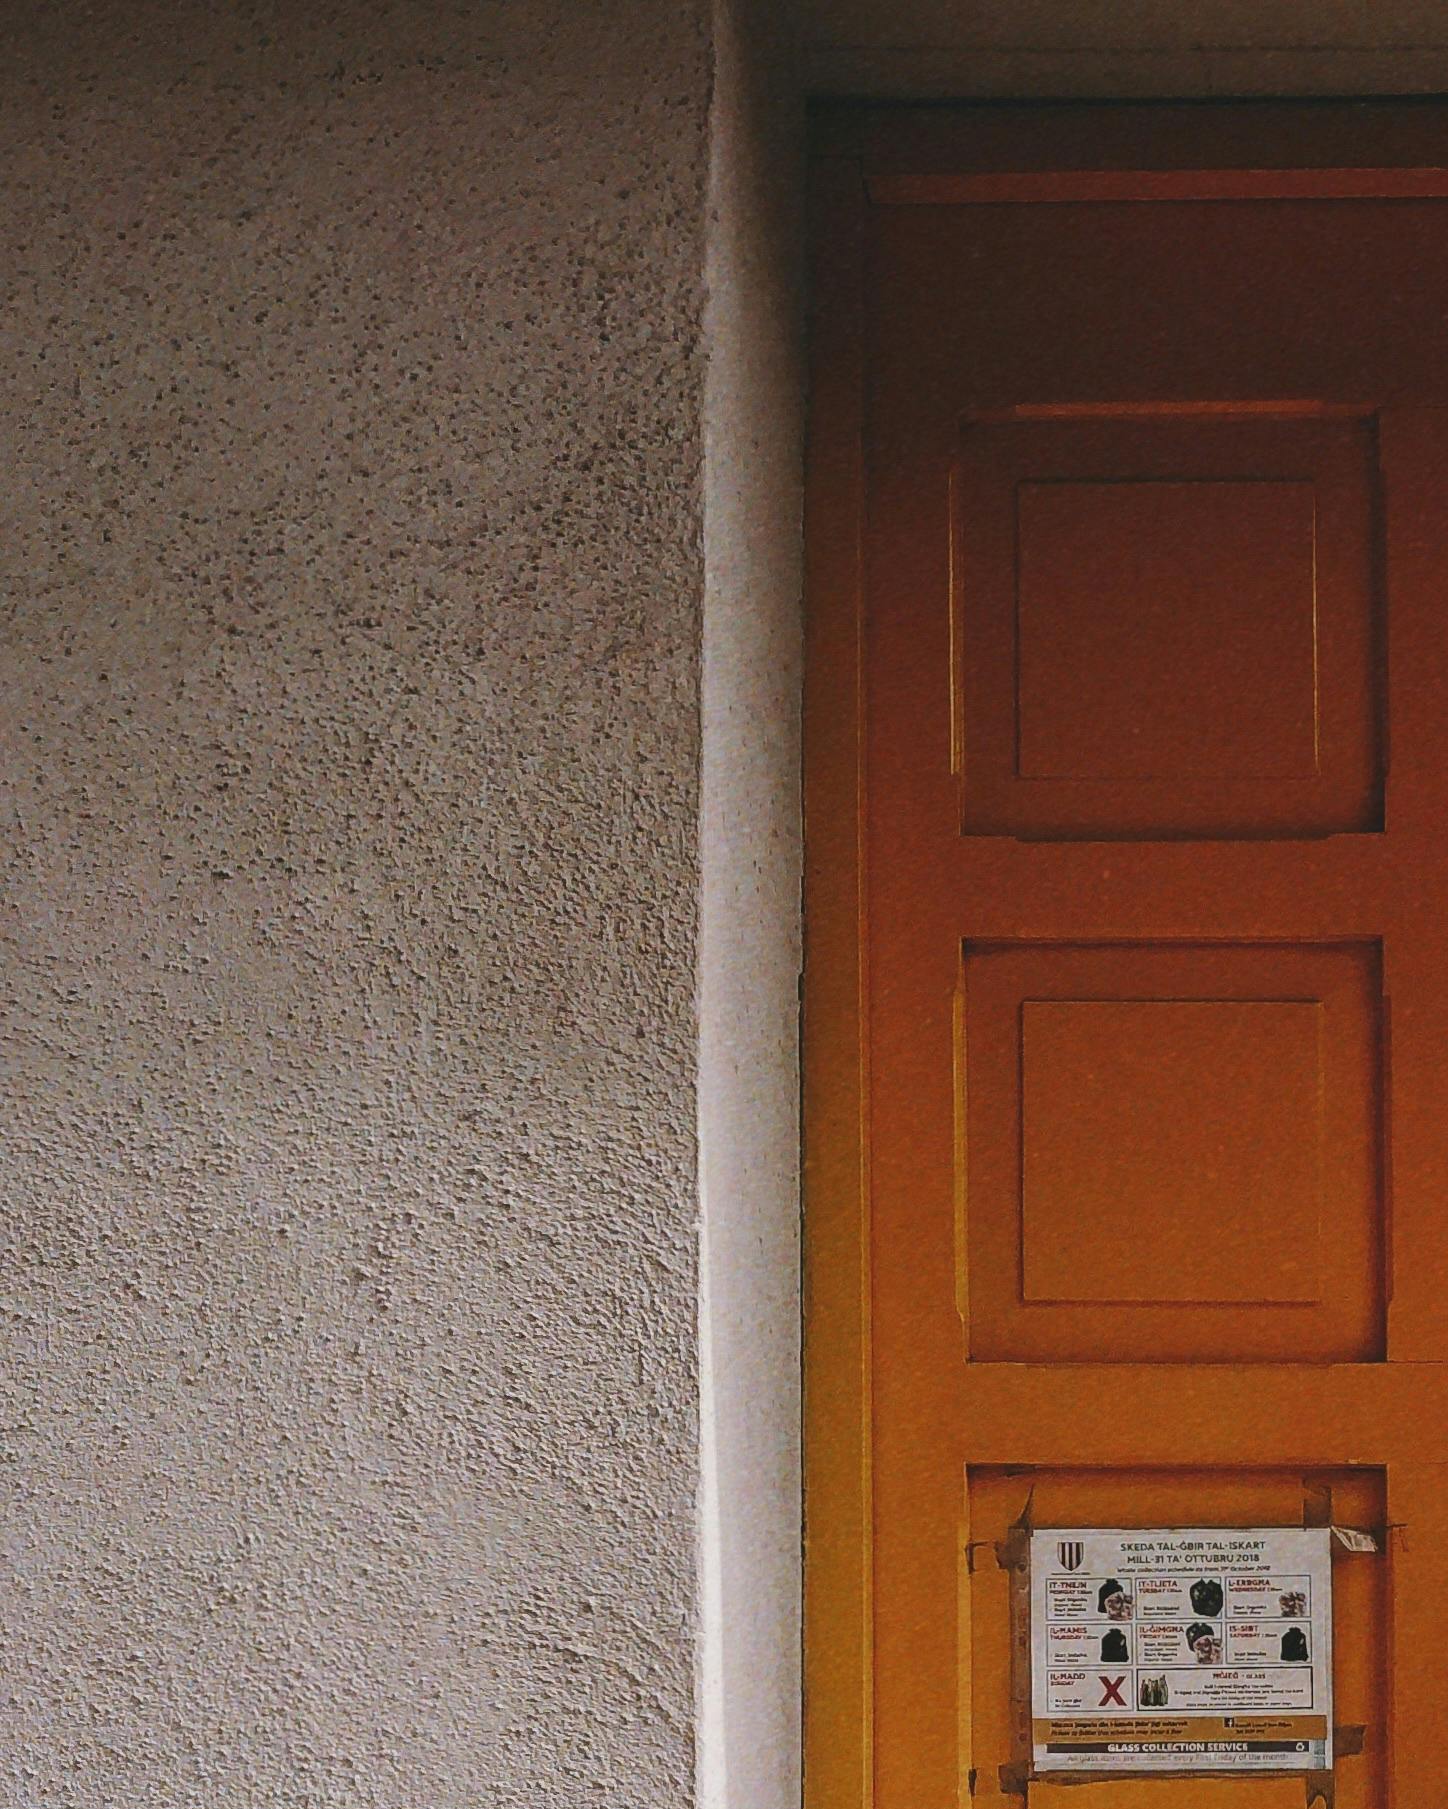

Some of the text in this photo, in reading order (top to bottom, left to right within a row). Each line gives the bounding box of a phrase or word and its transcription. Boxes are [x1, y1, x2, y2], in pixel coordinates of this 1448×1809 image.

[1120, 1543, 1155, 1552] SKEDA
[1205, 1541, 1266, 1551] TAL-ISKART
[1184, 1554, 1234, 1563] OTTUBRU
[1236, 1554, 1260, 1562] 2018
[1107, 1742, 1248, 1752] GLASS COLLECTION SERVICE
